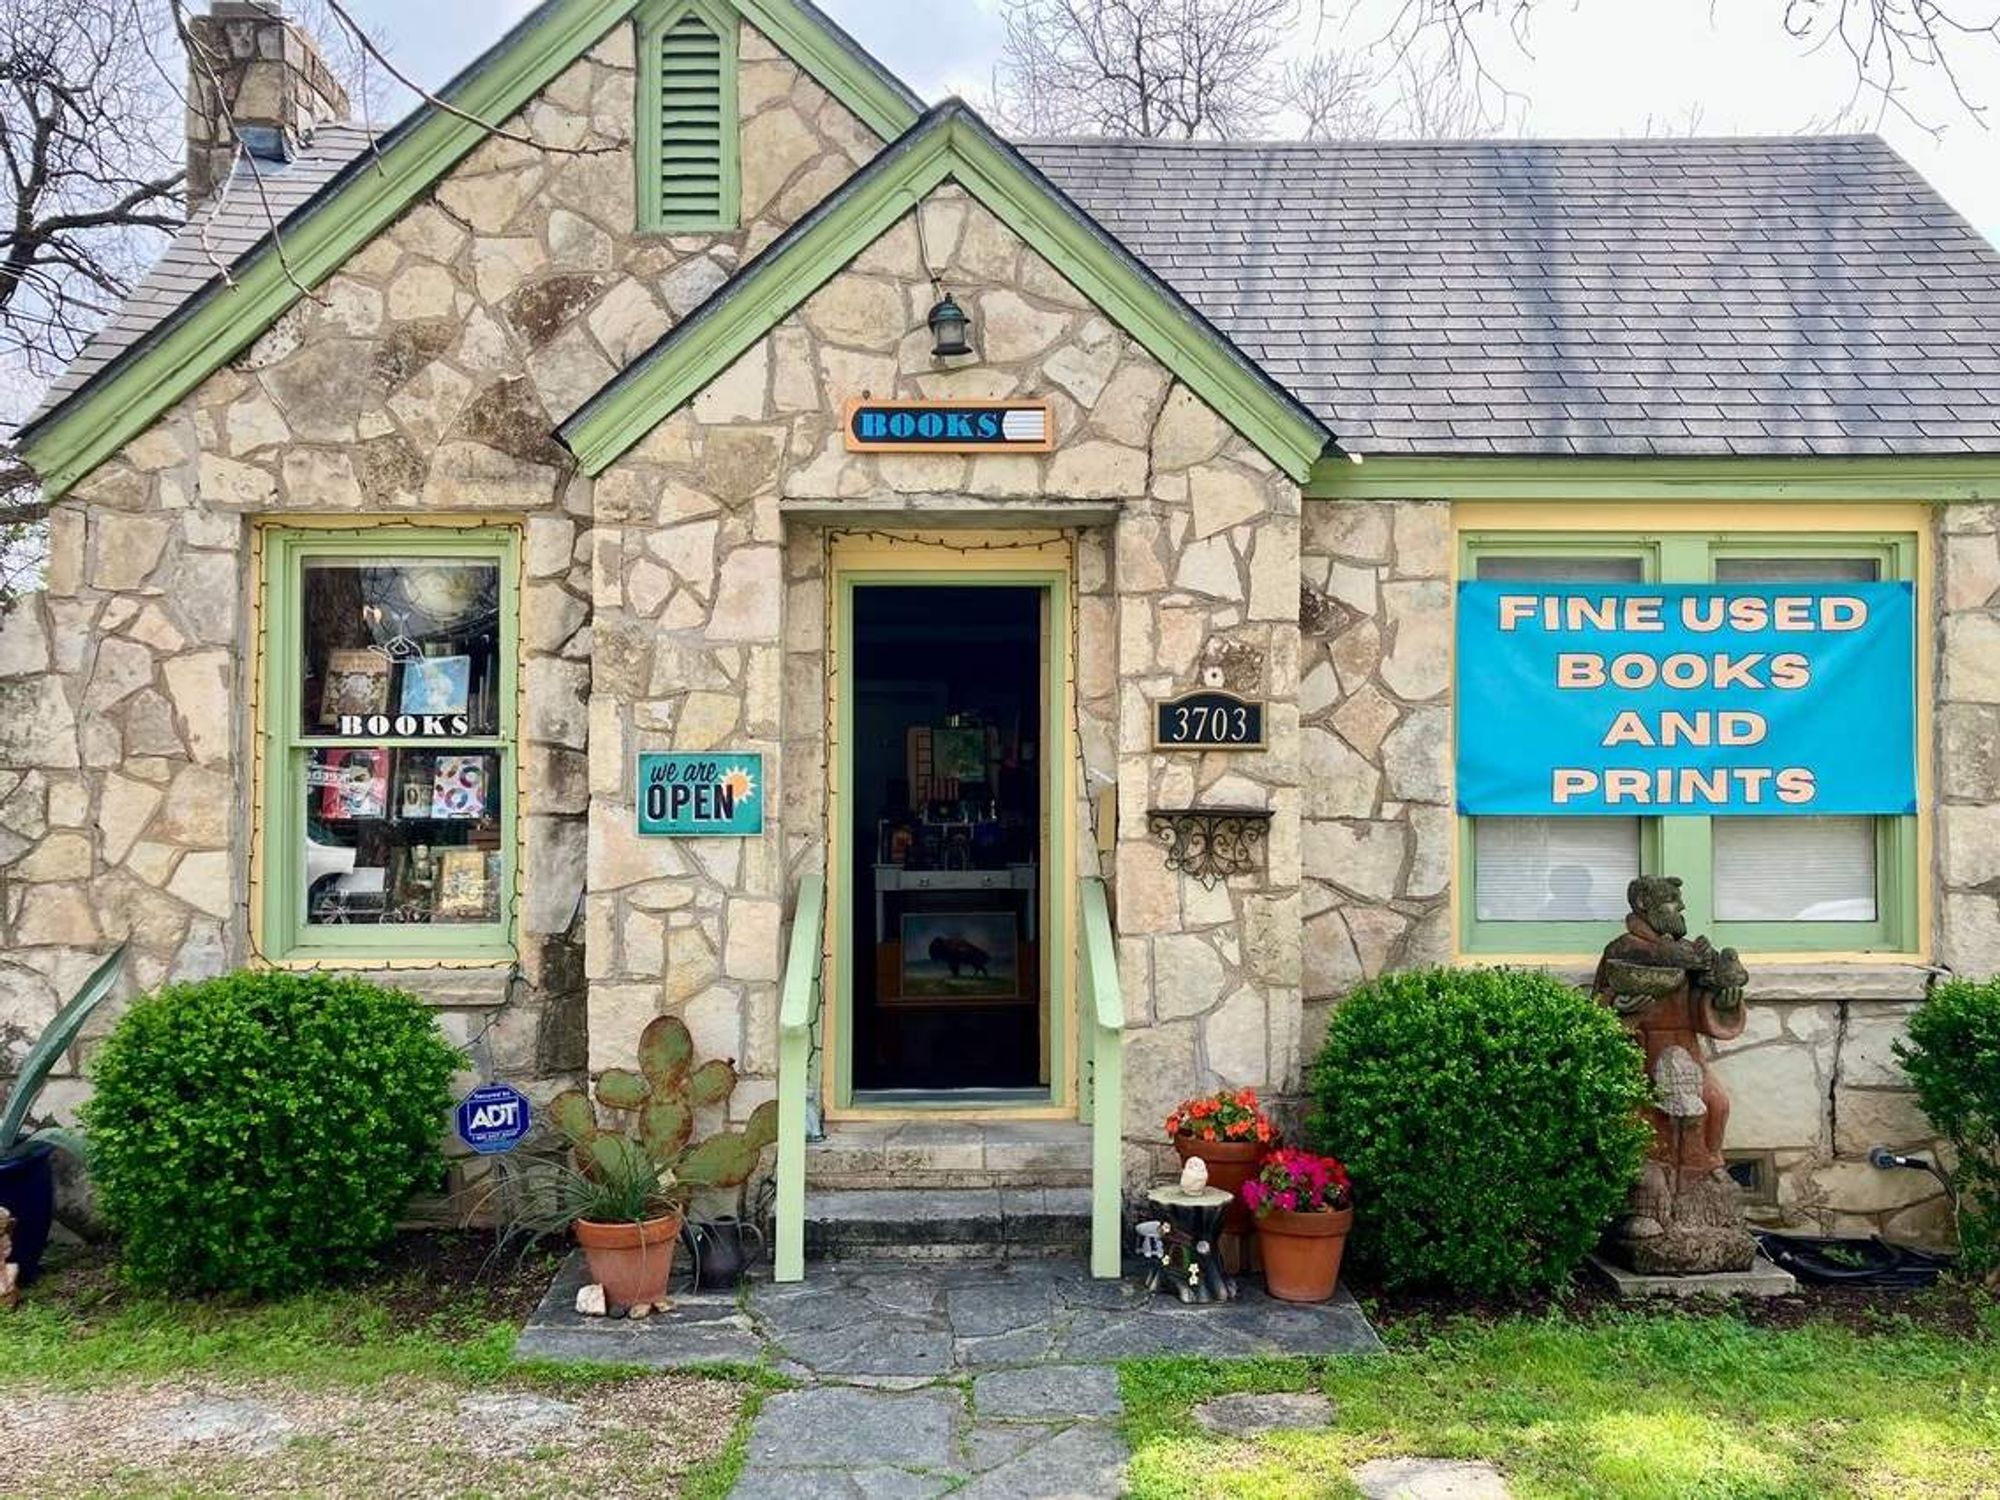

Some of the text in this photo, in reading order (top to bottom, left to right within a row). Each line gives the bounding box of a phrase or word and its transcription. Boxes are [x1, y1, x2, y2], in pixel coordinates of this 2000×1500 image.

[861, 412, 997, 438] BOOKS
[1498, 595, 1867, 632] FINE USED
[1556, 652, 1811, 690] BOOKS
[341, 714, 469, 736] BOOKS
[1172, 706, 1247, 741] 3703
[1601, 710, 1768, 747] AND
[650, 761, 720, 783] we are
[1552, 767, 1817, 805] PRINTS
[646, 783, 734, 821] OPEN
[469, 1102, 518, 1129] ADT
